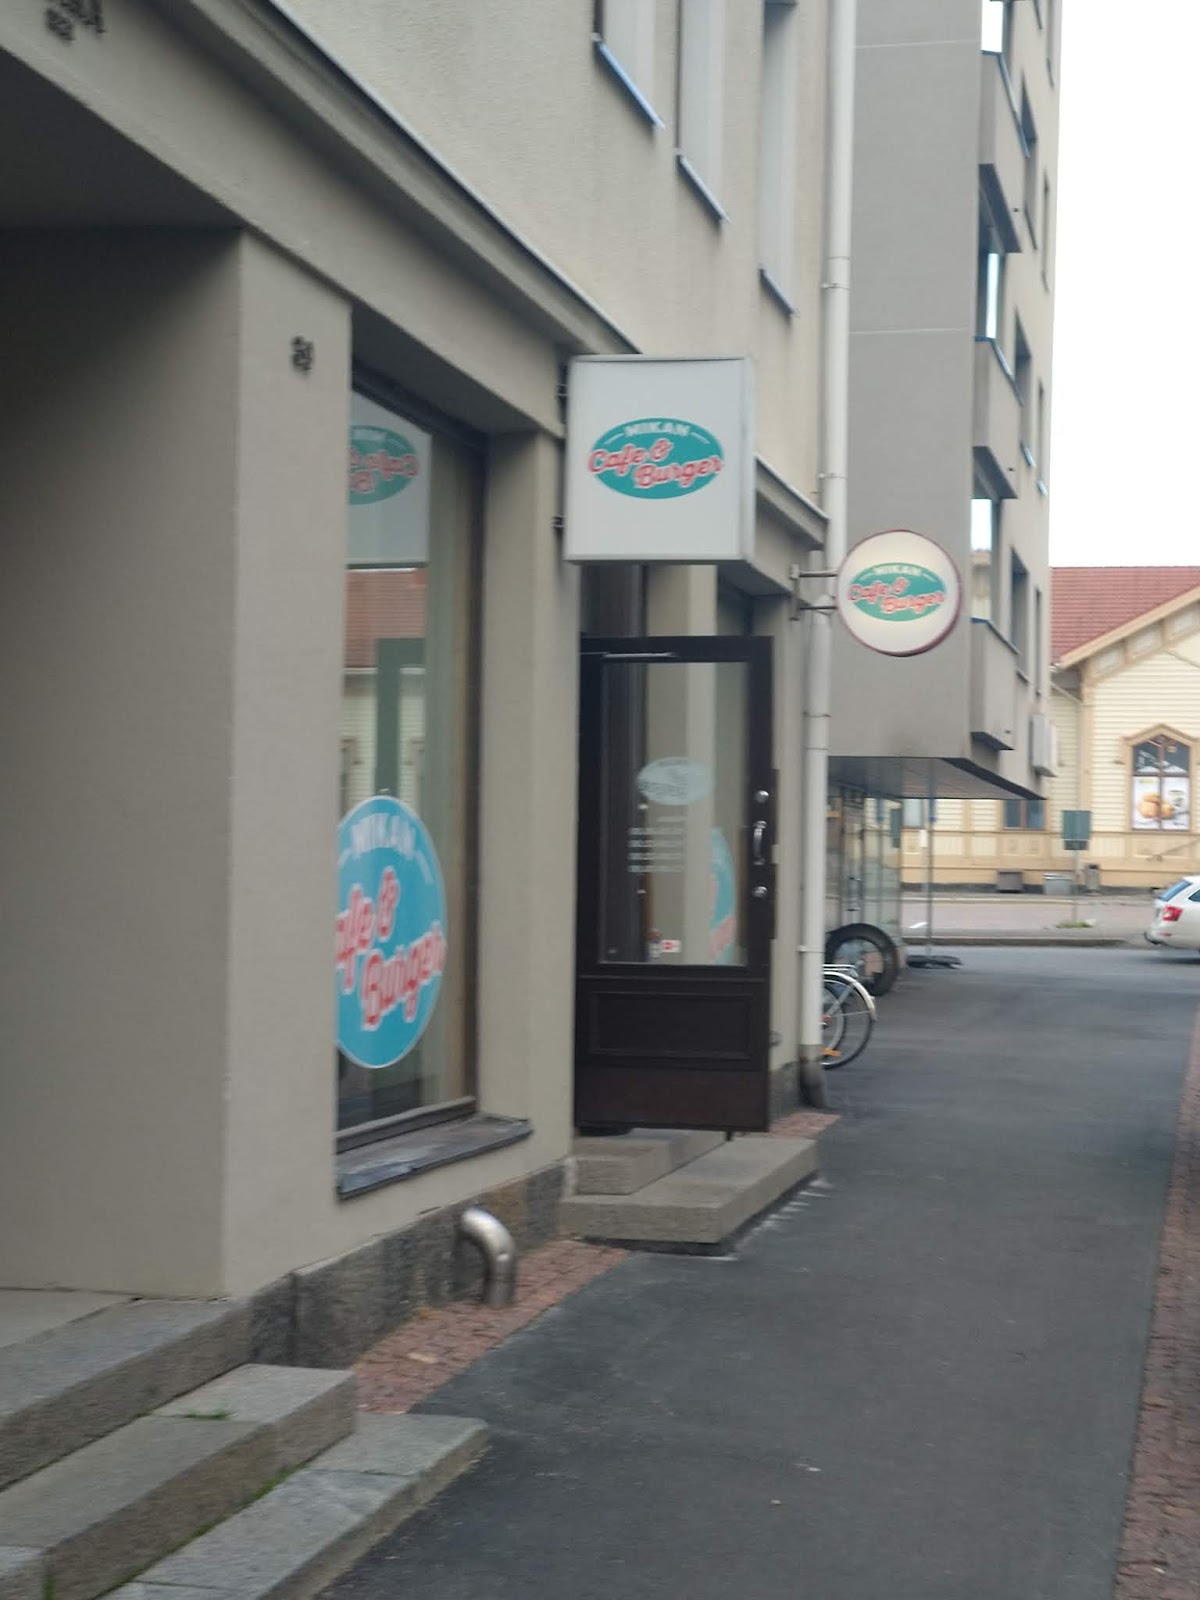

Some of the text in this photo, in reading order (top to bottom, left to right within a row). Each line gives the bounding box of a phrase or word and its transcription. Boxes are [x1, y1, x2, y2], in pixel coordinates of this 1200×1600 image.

[634, 454, 724, 489] Burger
[880, 591, 945, 614] Burger
[360, 920, 446, 1032] Burger
